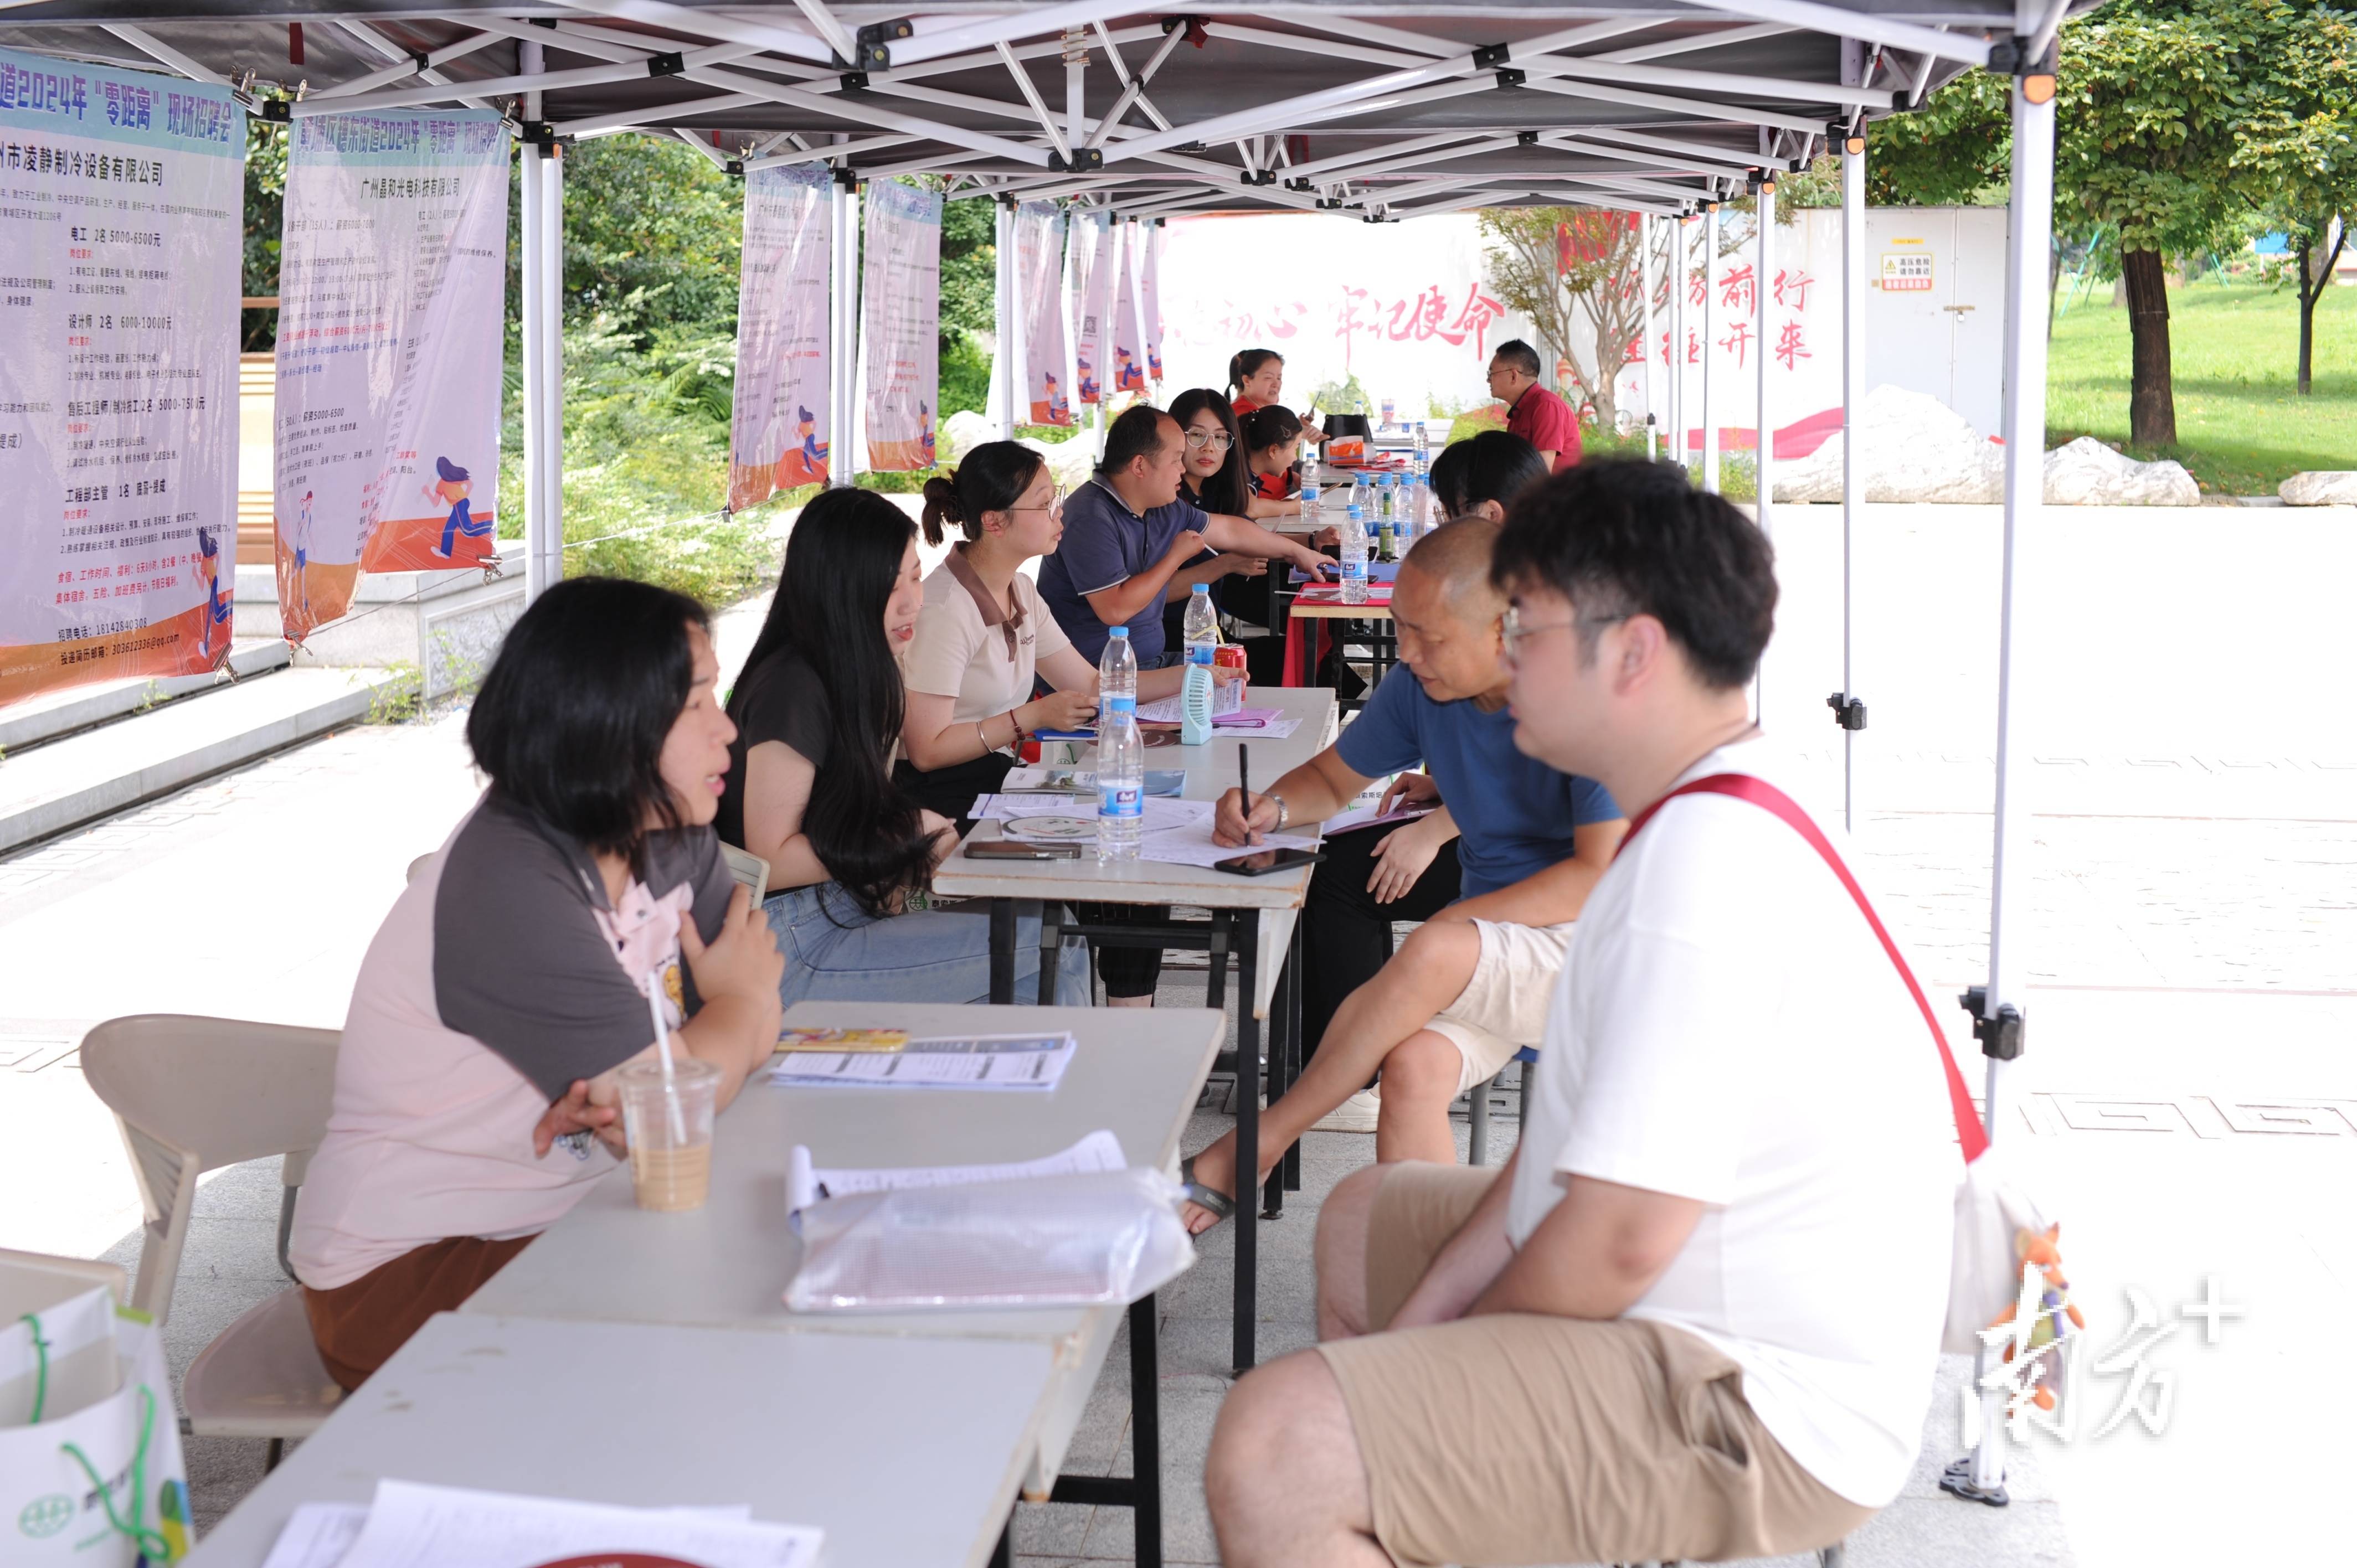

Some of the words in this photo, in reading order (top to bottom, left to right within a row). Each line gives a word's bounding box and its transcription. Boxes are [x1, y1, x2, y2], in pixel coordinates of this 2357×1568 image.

[361, 177, 460, 199] 广州晶和光电科技有限公司
[71, 226, 87, 241] 电工
[95, 228, 105, 243] 2名
[110, 230, 161, 247] 5000-6500元
[69, 314, 92, 329] 设计师
[100, 314, 112, 330] 2名
[121, 316, 171, 330] 6000-10000元
[1331, 282, 1505, 370] 牢记使命
[159, 396, 205, 411] 5000-7500元
[65, 485, 109, 503] 工程部主管
[119, 483, 129, 498] 1名
